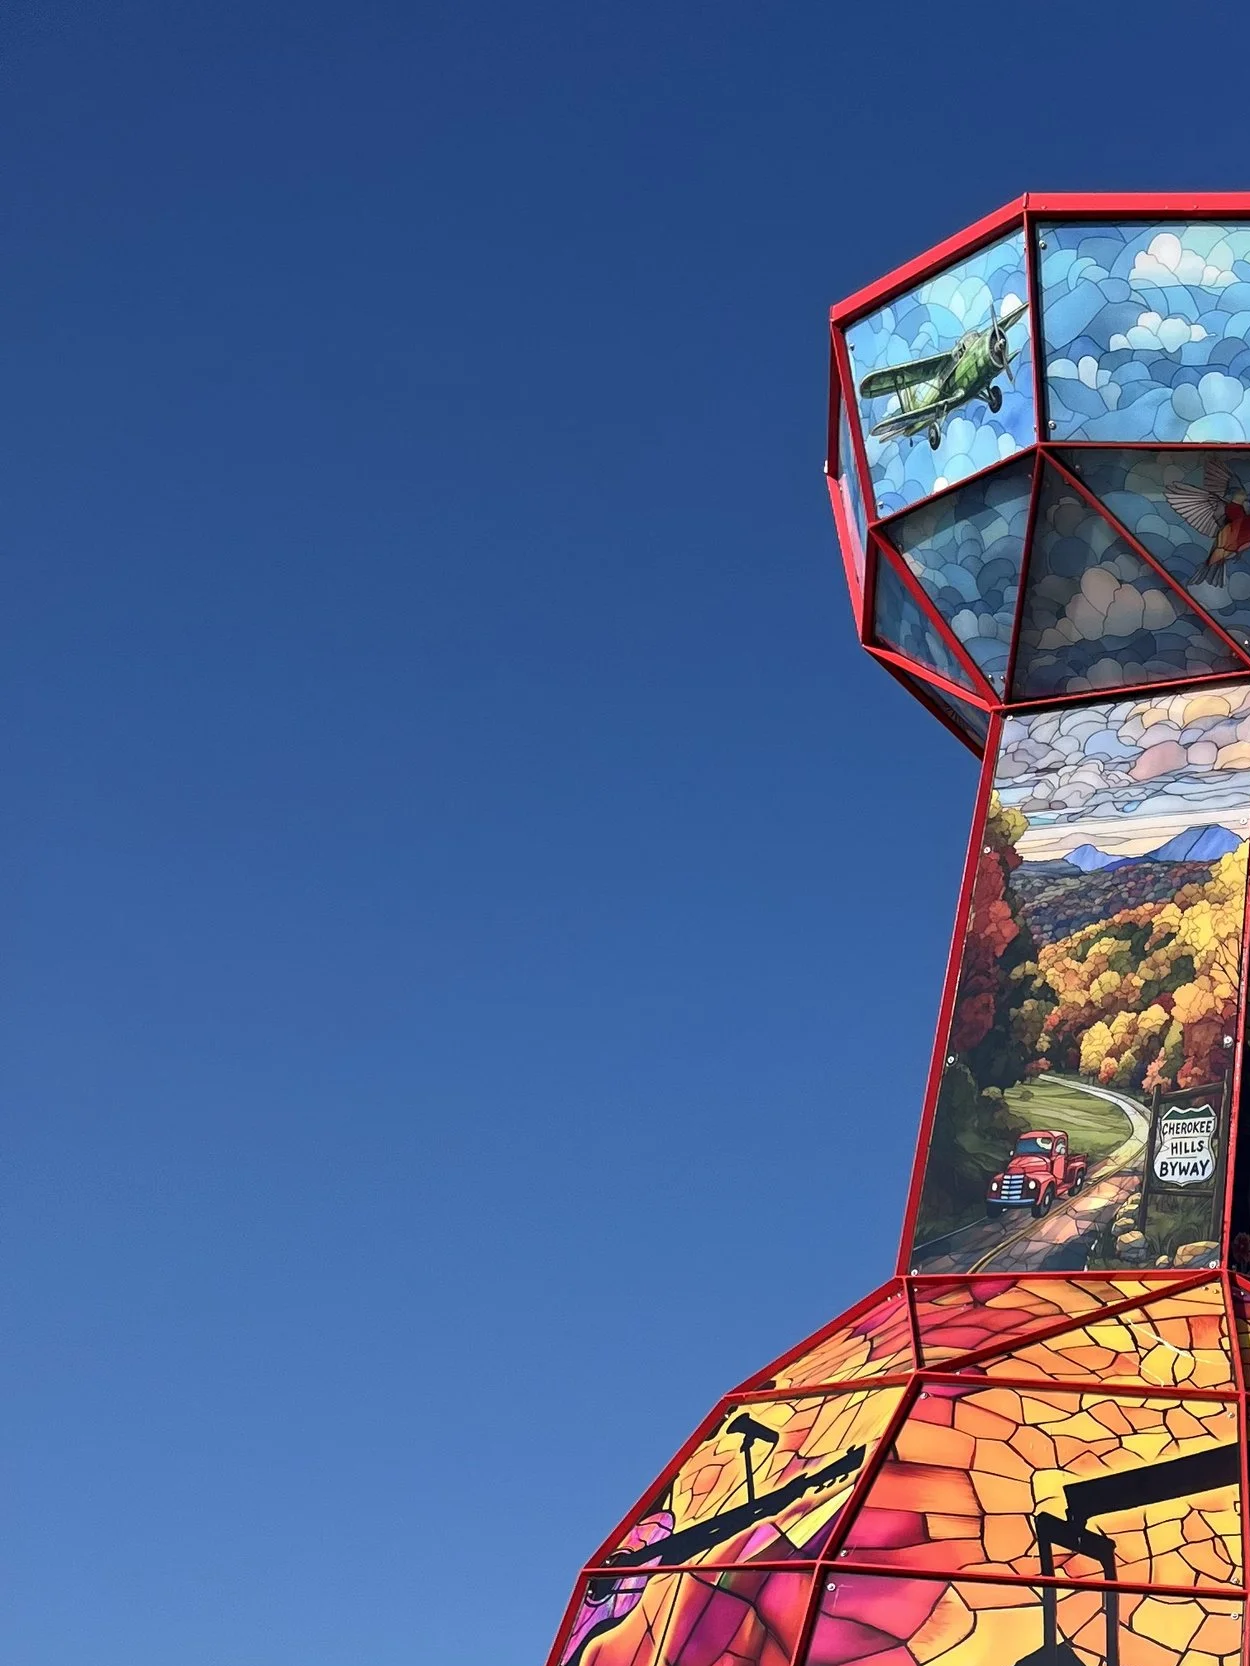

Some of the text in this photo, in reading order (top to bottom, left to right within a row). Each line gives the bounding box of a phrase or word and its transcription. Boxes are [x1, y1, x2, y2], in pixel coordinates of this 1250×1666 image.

[1162, 1120, 1212, 1135] CHEROKEE
[1171, 1140, 1204, 1155] HILLS
[1160, 1159, 1210, 1177] BYWAY
